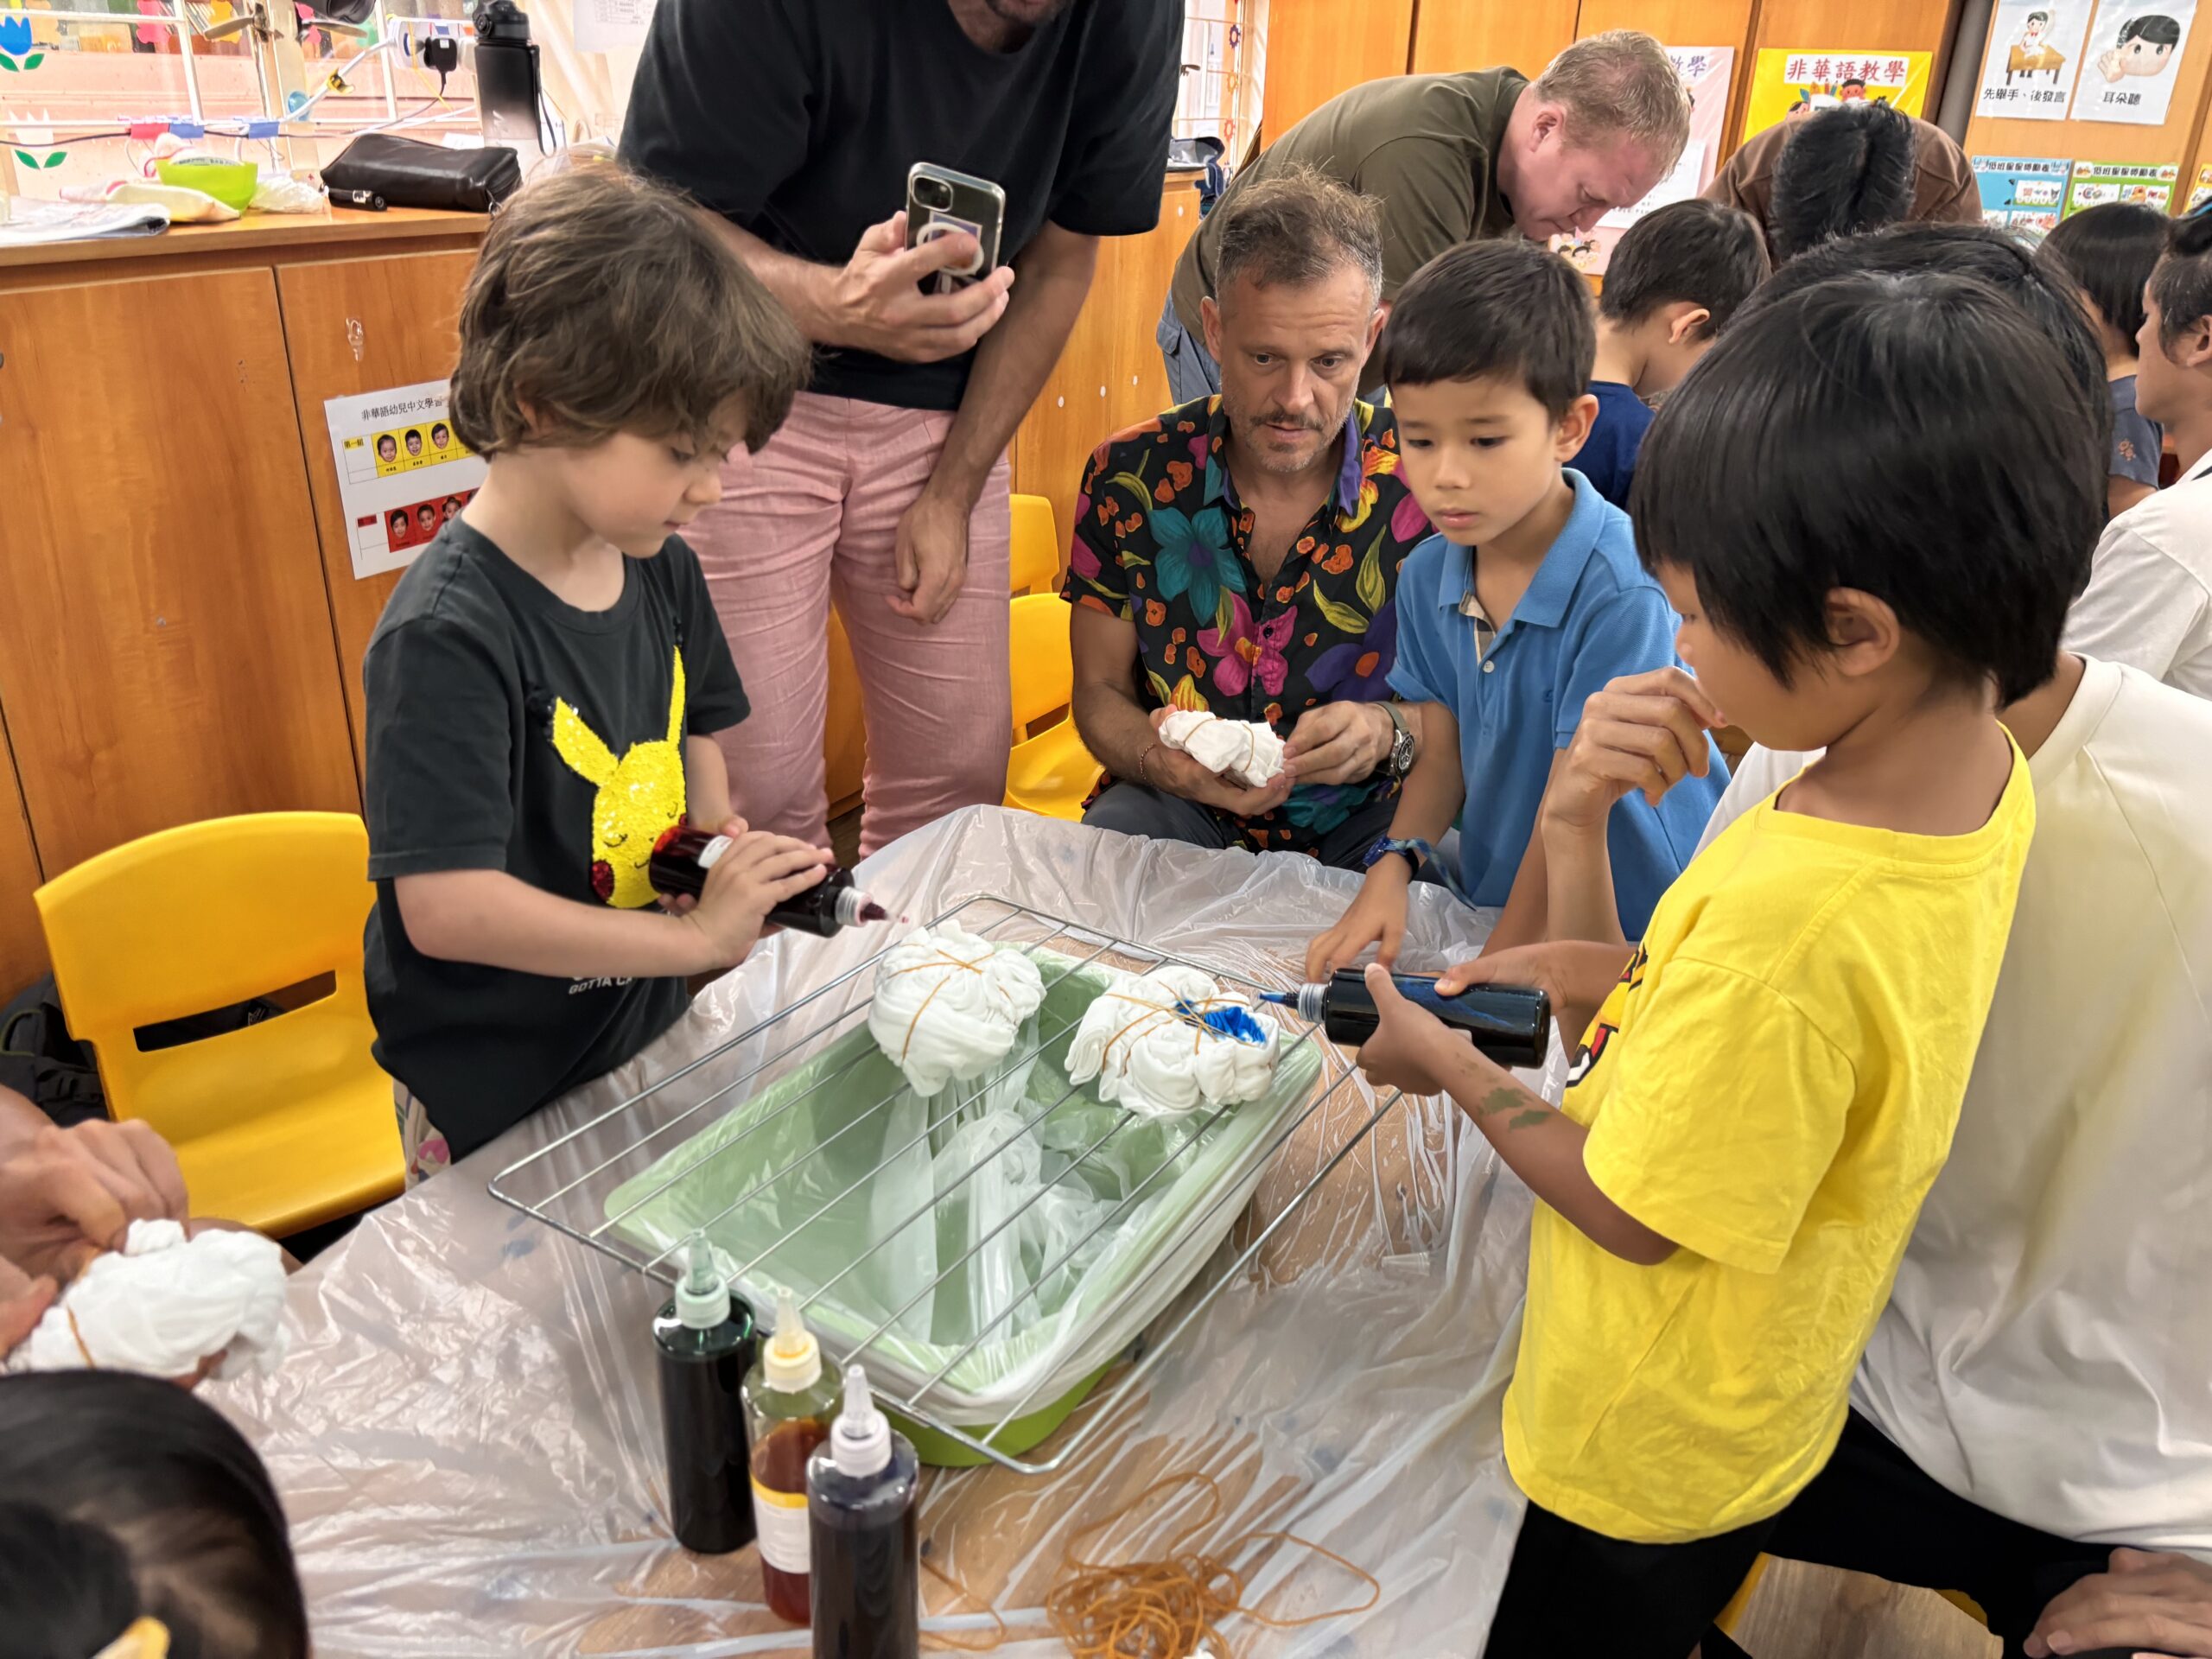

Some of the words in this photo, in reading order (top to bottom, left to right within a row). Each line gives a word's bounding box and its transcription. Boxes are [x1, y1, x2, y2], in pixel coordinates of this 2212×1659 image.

[1787, 58, 1905, 83] 非華語教學
[1984, 88, 2066, 103] 先舉手、後發言
[2103, 91, 2142, 105] 耳朵聽
[569, 976, 613, 995] GOTTA
